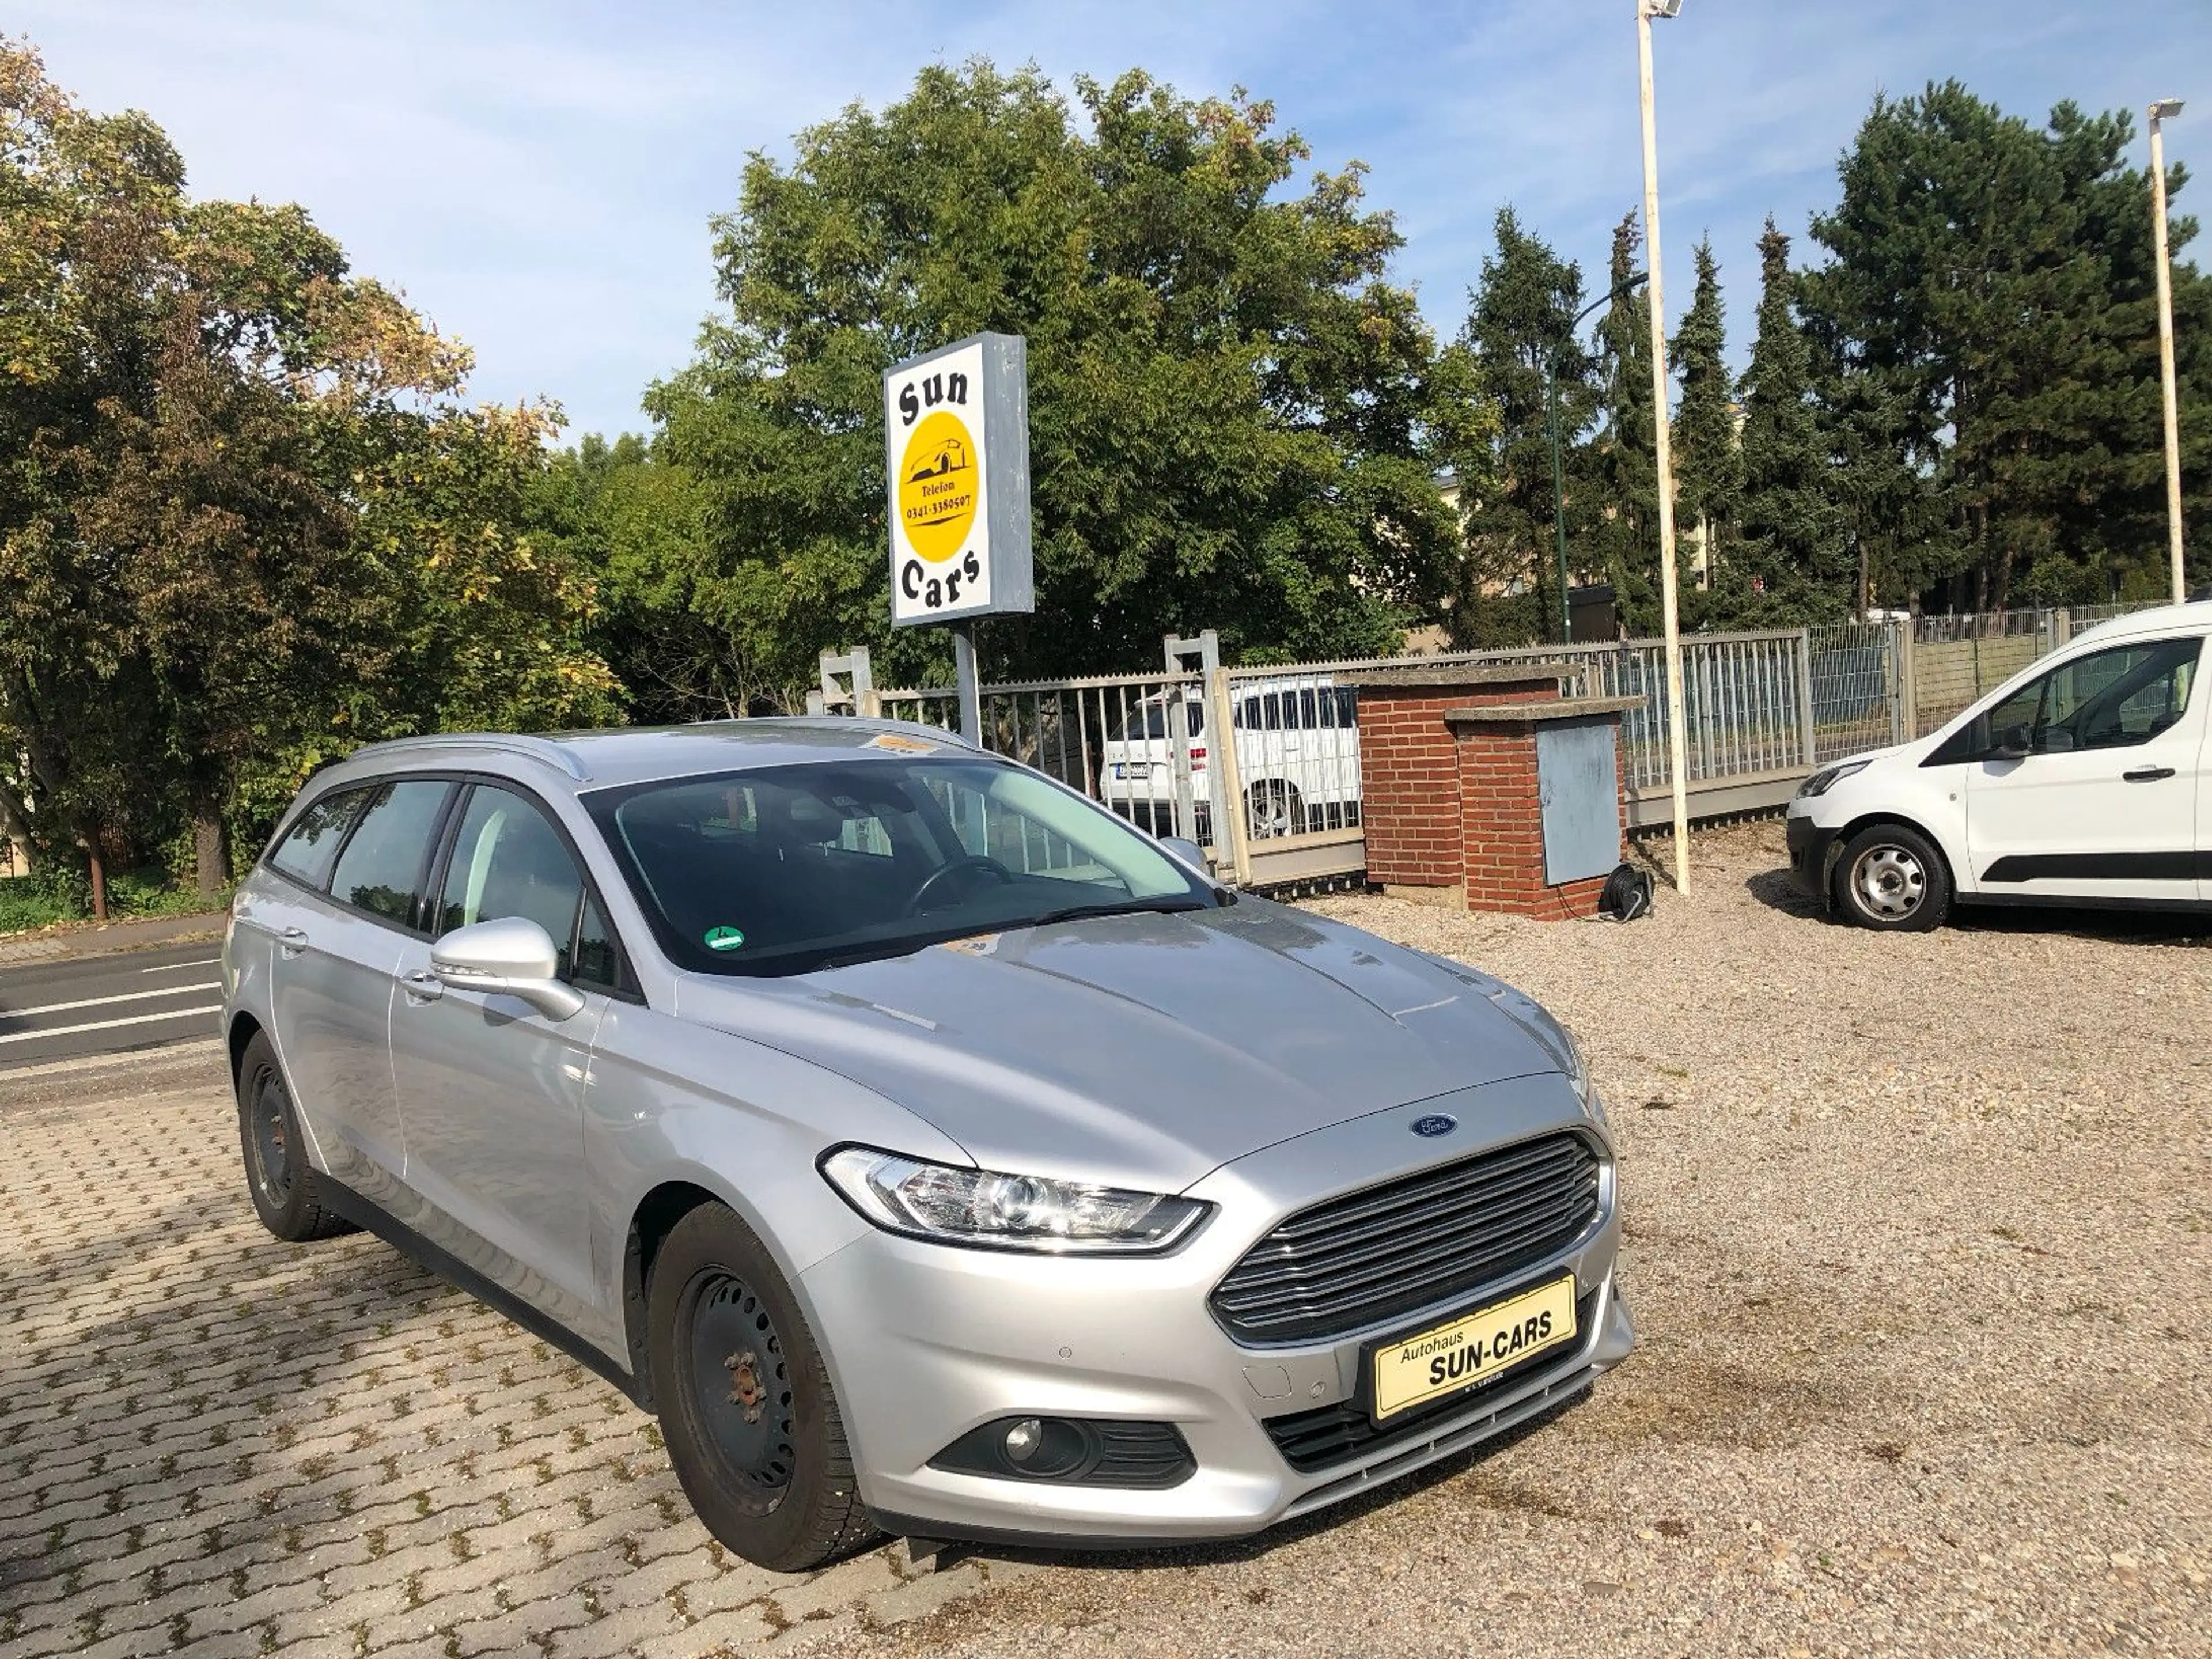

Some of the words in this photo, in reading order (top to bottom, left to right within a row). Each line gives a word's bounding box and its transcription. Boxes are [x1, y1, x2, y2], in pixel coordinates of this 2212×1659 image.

[899, 372, 967, 425] Sun
[922, 482, 954, 497] Telefon
[902, 551, 979, 608] Cars
[1421, 1119, 1448, 1133] Ford
[1400, 1331, 1464, 1363] Autohaus
[1429, 1310, 1552, 1385] SUN-CARS
